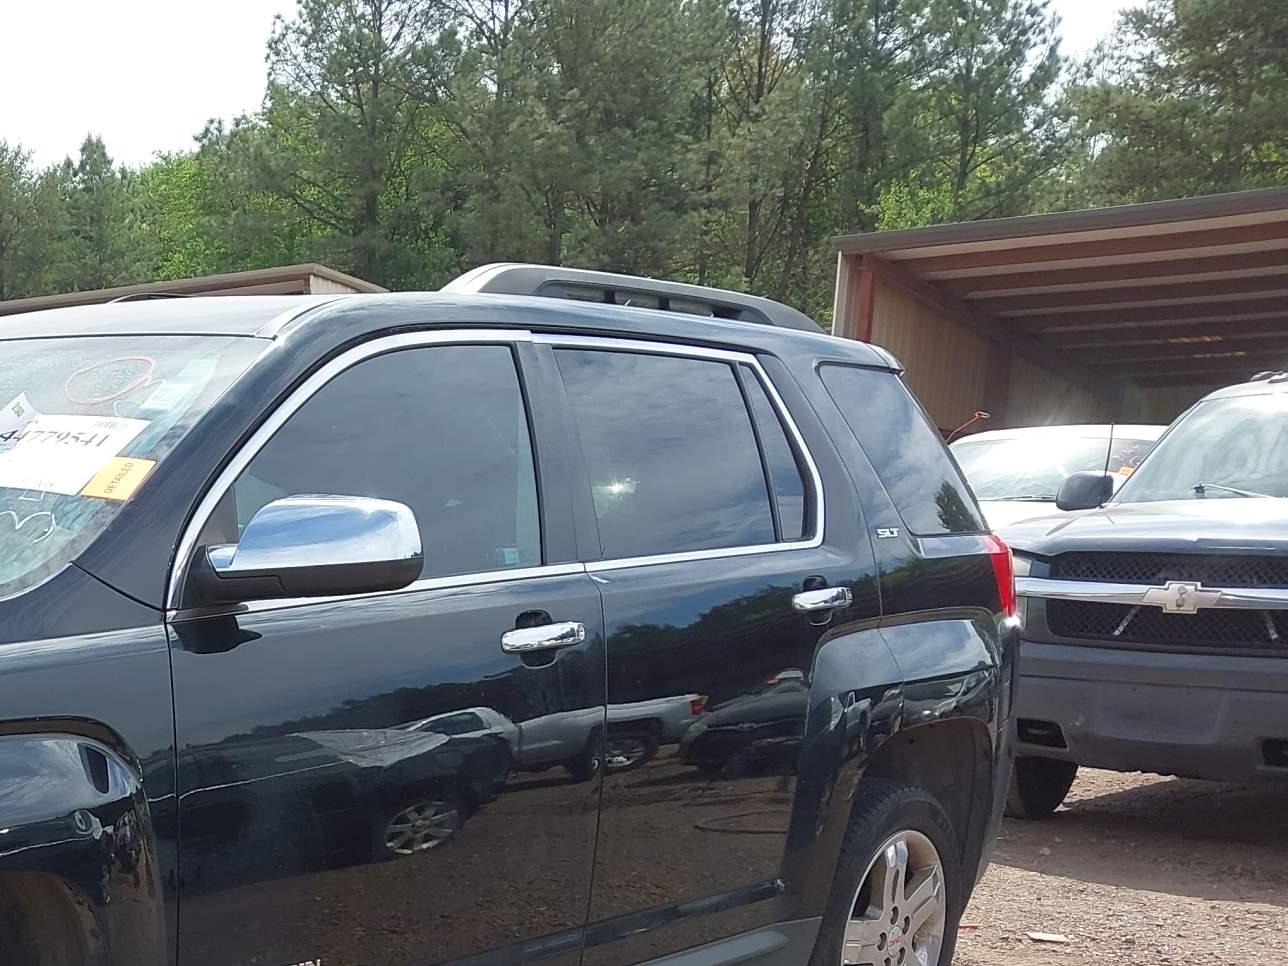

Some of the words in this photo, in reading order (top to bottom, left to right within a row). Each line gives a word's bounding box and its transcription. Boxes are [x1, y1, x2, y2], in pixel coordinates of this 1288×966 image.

[0, 428, 111, 447] 44779541
[103, 462, 134, 494] DETAILED
[876, 527, 900, 538] SLT
